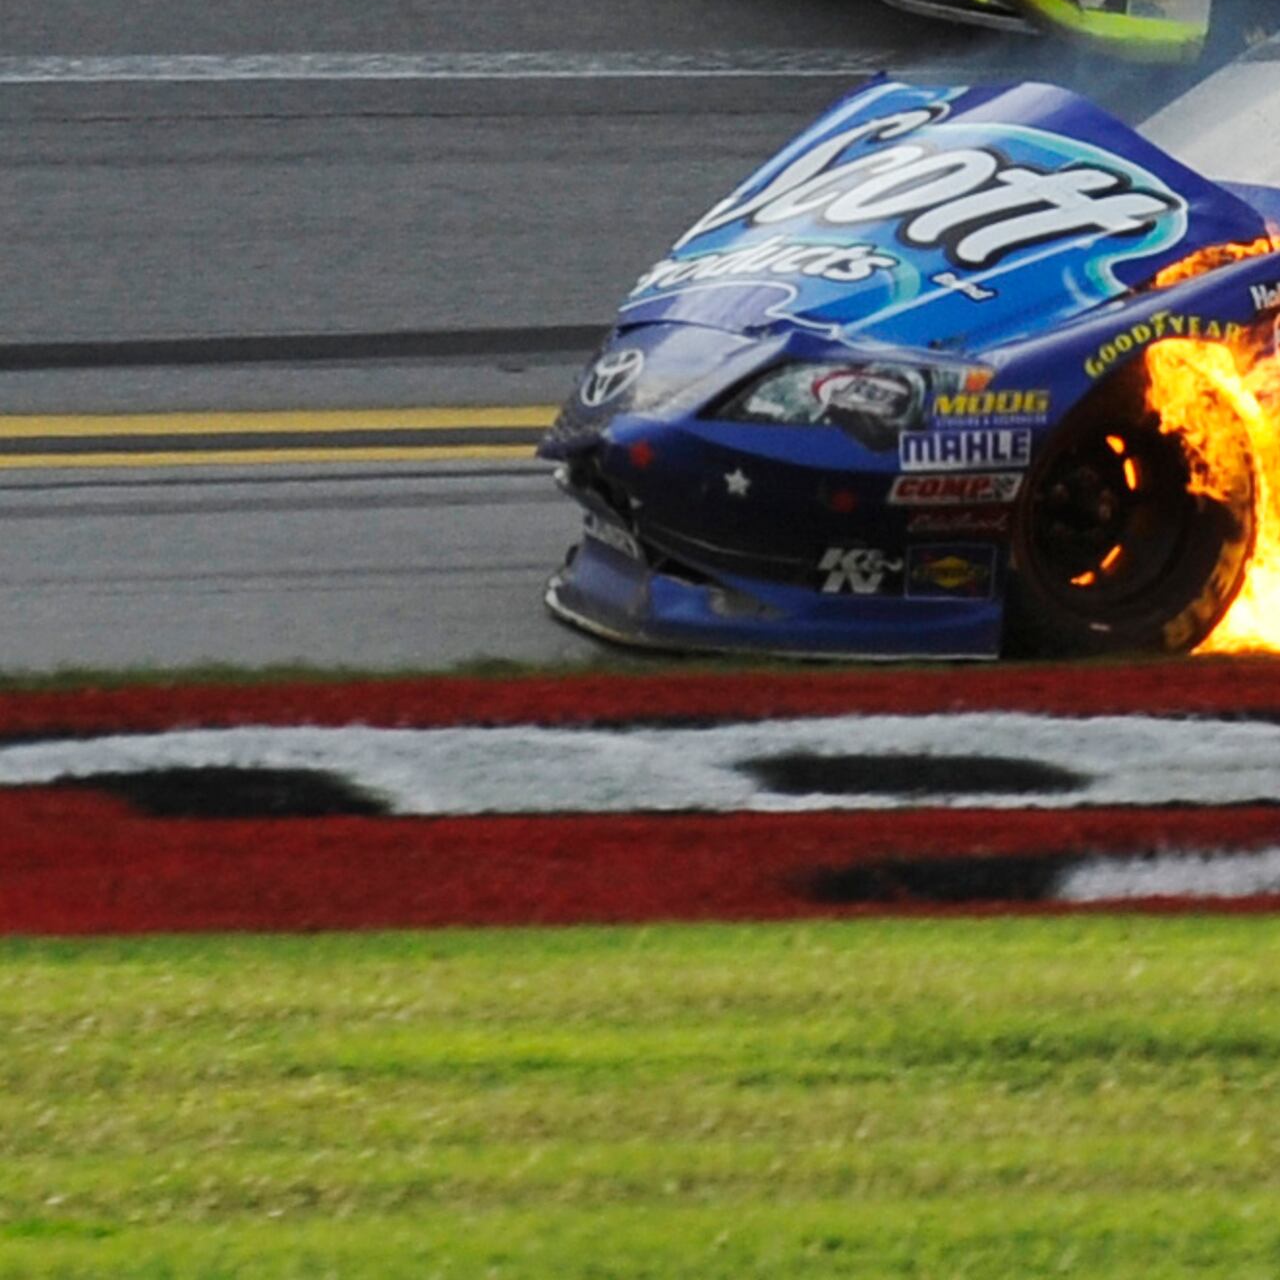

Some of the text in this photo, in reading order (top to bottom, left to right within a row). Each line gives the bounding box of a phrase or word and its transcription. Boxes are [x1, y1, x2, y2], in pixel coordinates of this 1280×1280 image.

[670, 107, 1174, 266] Scott
[629, 235, 897, 298] roducts
[1085, 310, 1242, 378] GOODYEAR
[932, 390, 1049, 417] MOOG
[903, 432, 1029, 463] MAHLE
[895, 478, 992, 499] COMP
